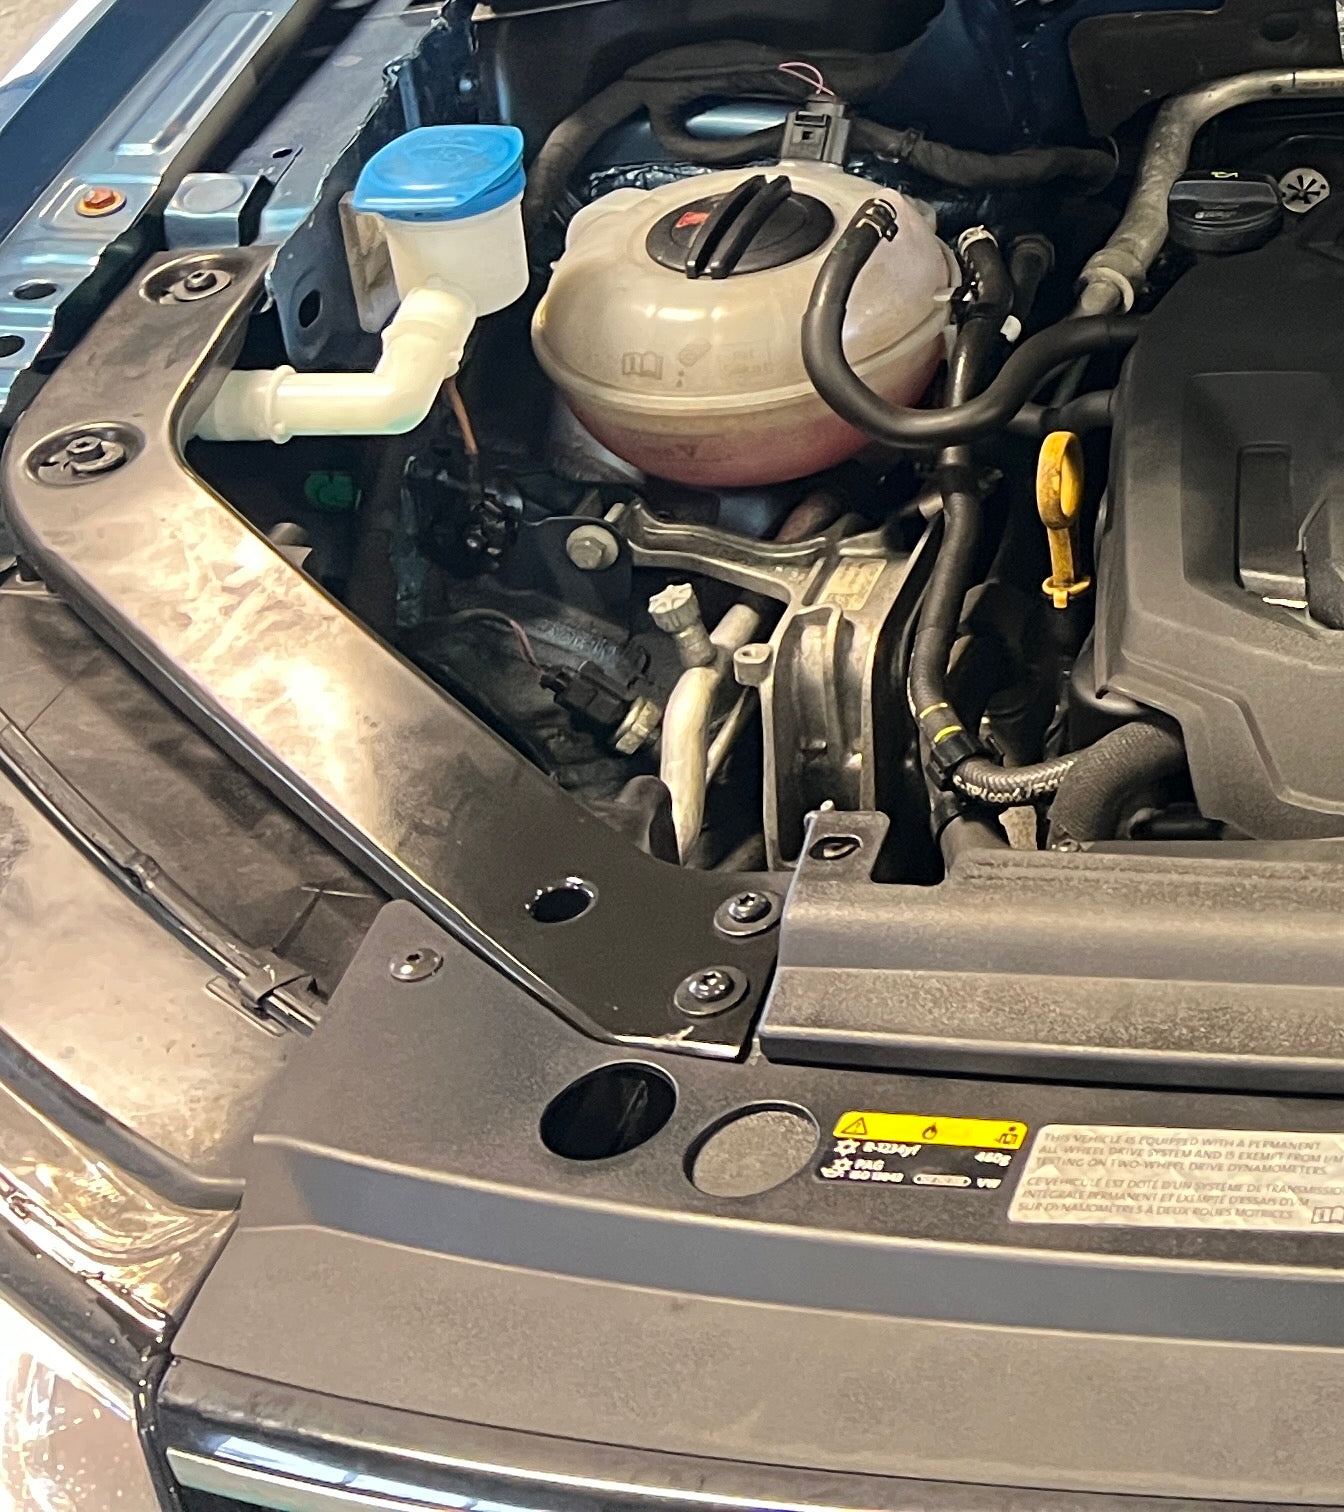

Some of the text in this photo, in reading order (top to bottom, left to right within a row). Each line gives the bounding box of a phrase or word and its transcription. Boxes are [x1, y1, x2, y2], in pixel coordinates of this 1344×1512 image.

[1073, 1134, 1121, 1144] VEHICLE
[1202, 1138, 1234, 1147] WITH
[1248, 1140, 1321, 1150] PERMANENT
[1108, 1147, 1143, 1156] DRIVE
[1147, 1148, 1192, 1158] SYSTEM
[1194, 1150, 1222, 1160] AND
[1238, 1152, 1283, 1162] EXEMPT
[1287, 1153, 1321, 1163] FROM
[854, 1158, 885, 1171] PAG
[1087, 1158, 1107, 1168] ON
[1189, 1162, 1224, 1172] DRIVE
